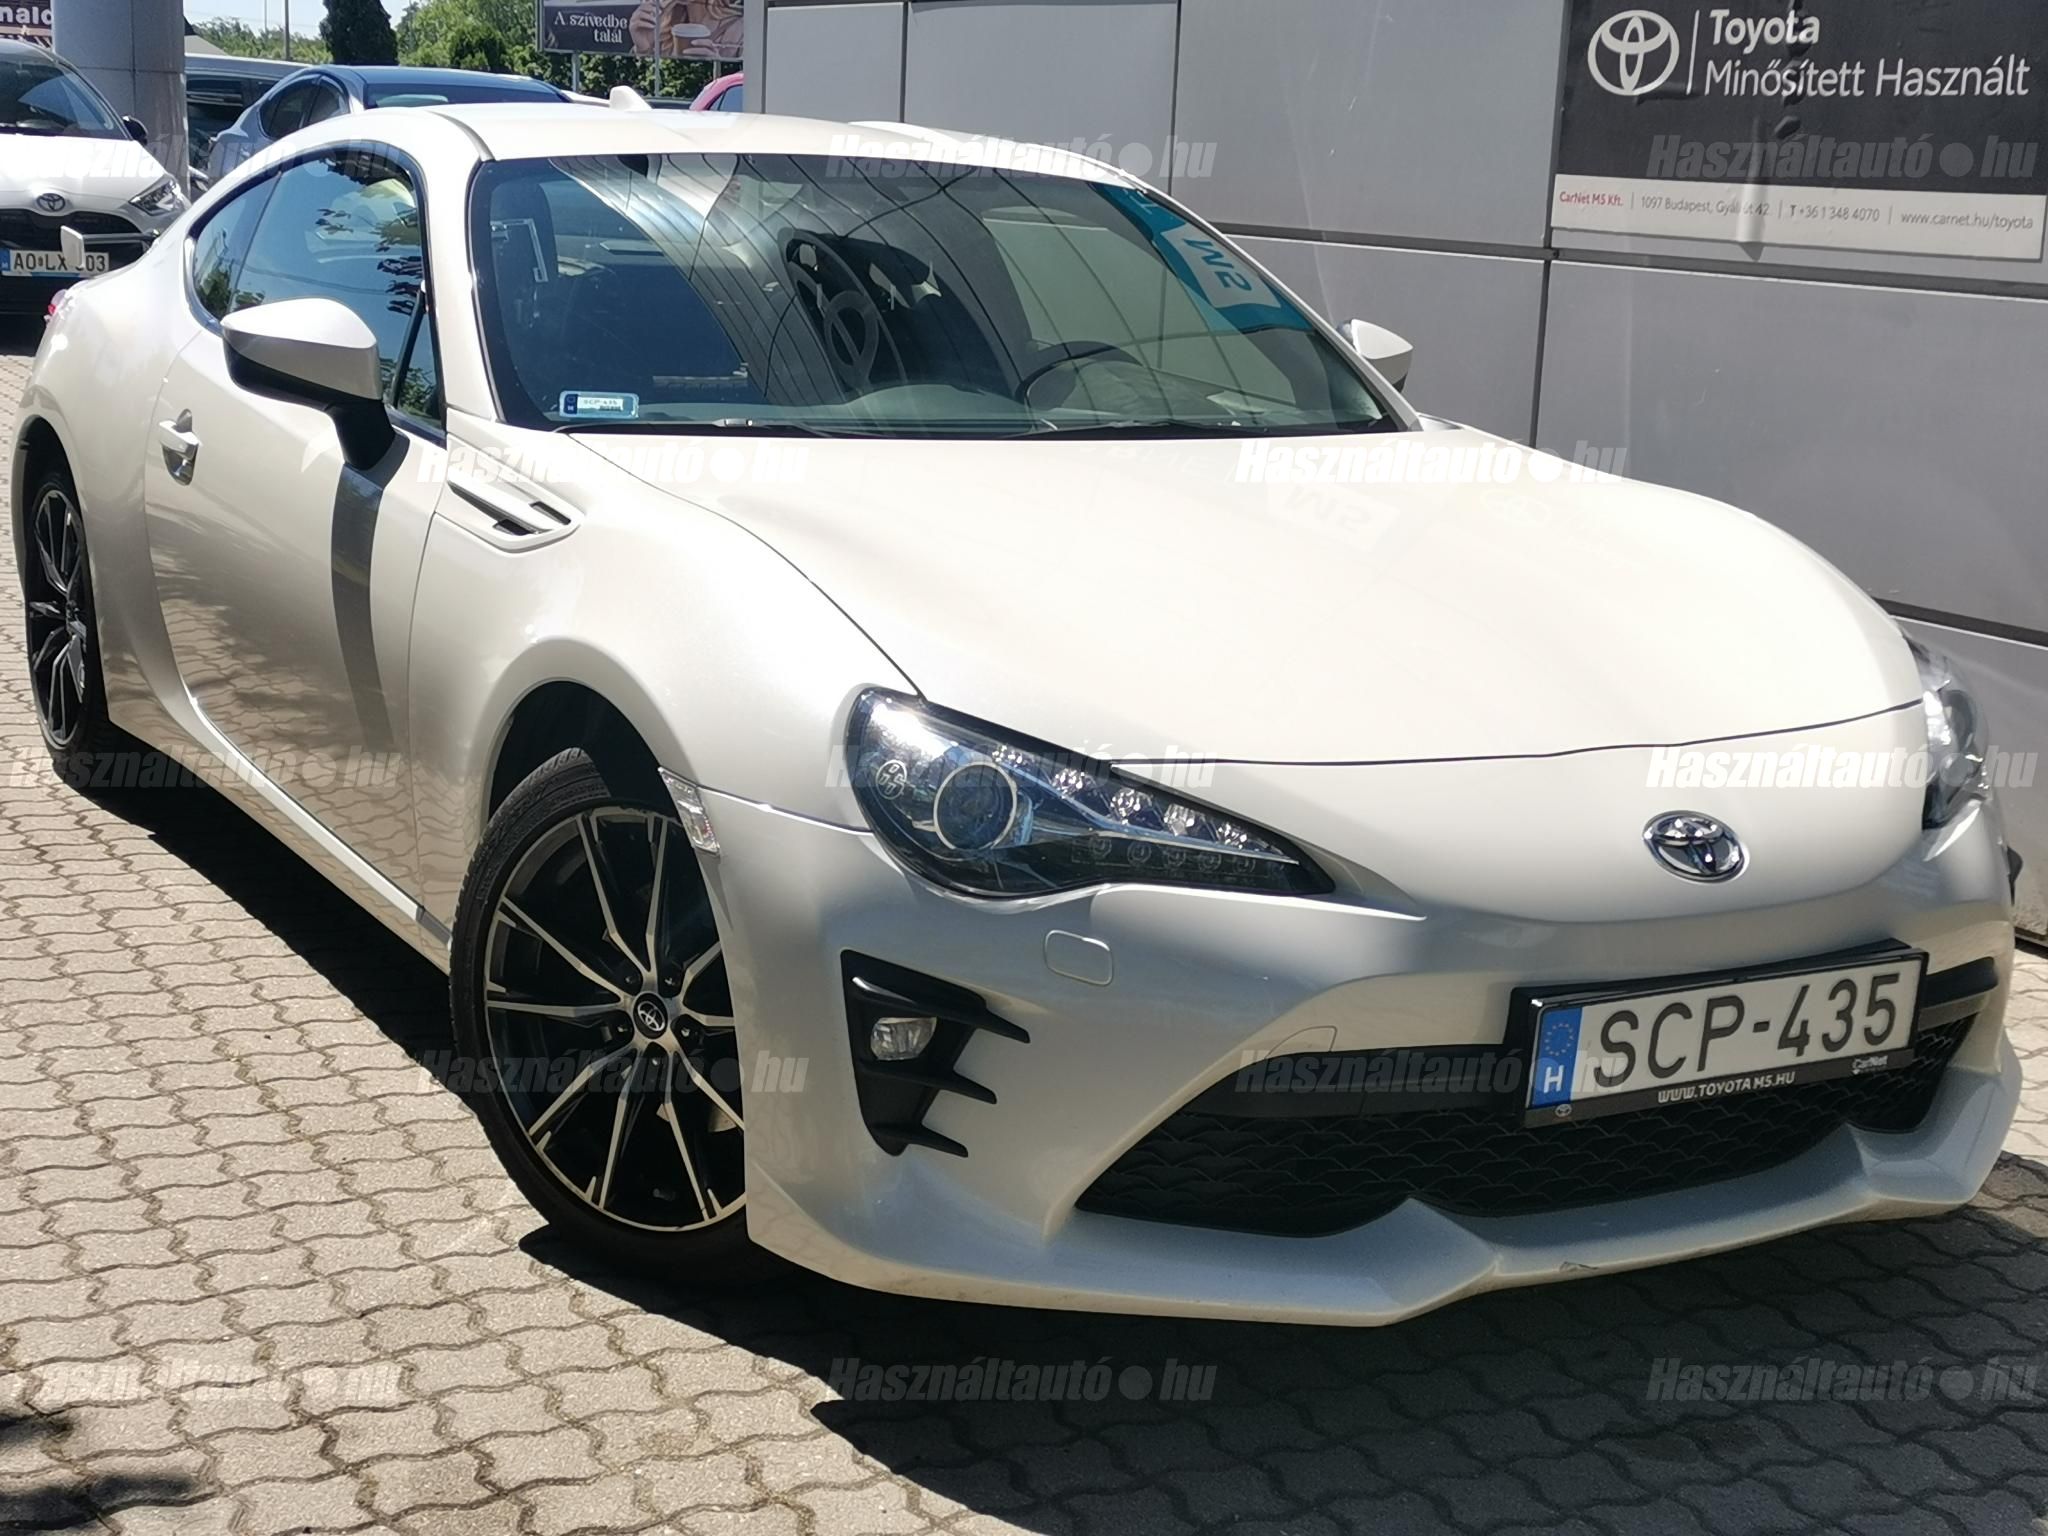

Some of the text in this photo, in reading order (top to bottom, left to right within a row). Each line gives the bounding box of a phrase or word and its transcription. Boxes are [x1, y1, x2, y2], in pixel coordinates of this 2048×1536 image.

[554, 11, 567, 25] A
[594, 28, 623, 43] talál
[1710, 9, 1820, 54] Toyota
[1704, 53, 2031, 97] Minősített Használt
[1559, 191, 1590, 205] CarNet
[1641, 196, 1663, 209] 1097
[1665, 198, 1713, 214] Budapest,
[1790, 204, 1798, 217] T
[1800, 205, 1818, 218] +36
[1829, 206, 1849, 220] 348
[1852, 207, 1880, 222] 4070
[1901, 211, 2034, 232] www.carnet.hu/toyota
[1593, 972, 1900, 1088] SCP-435
[1543, 1064, 1564, 1095] H
